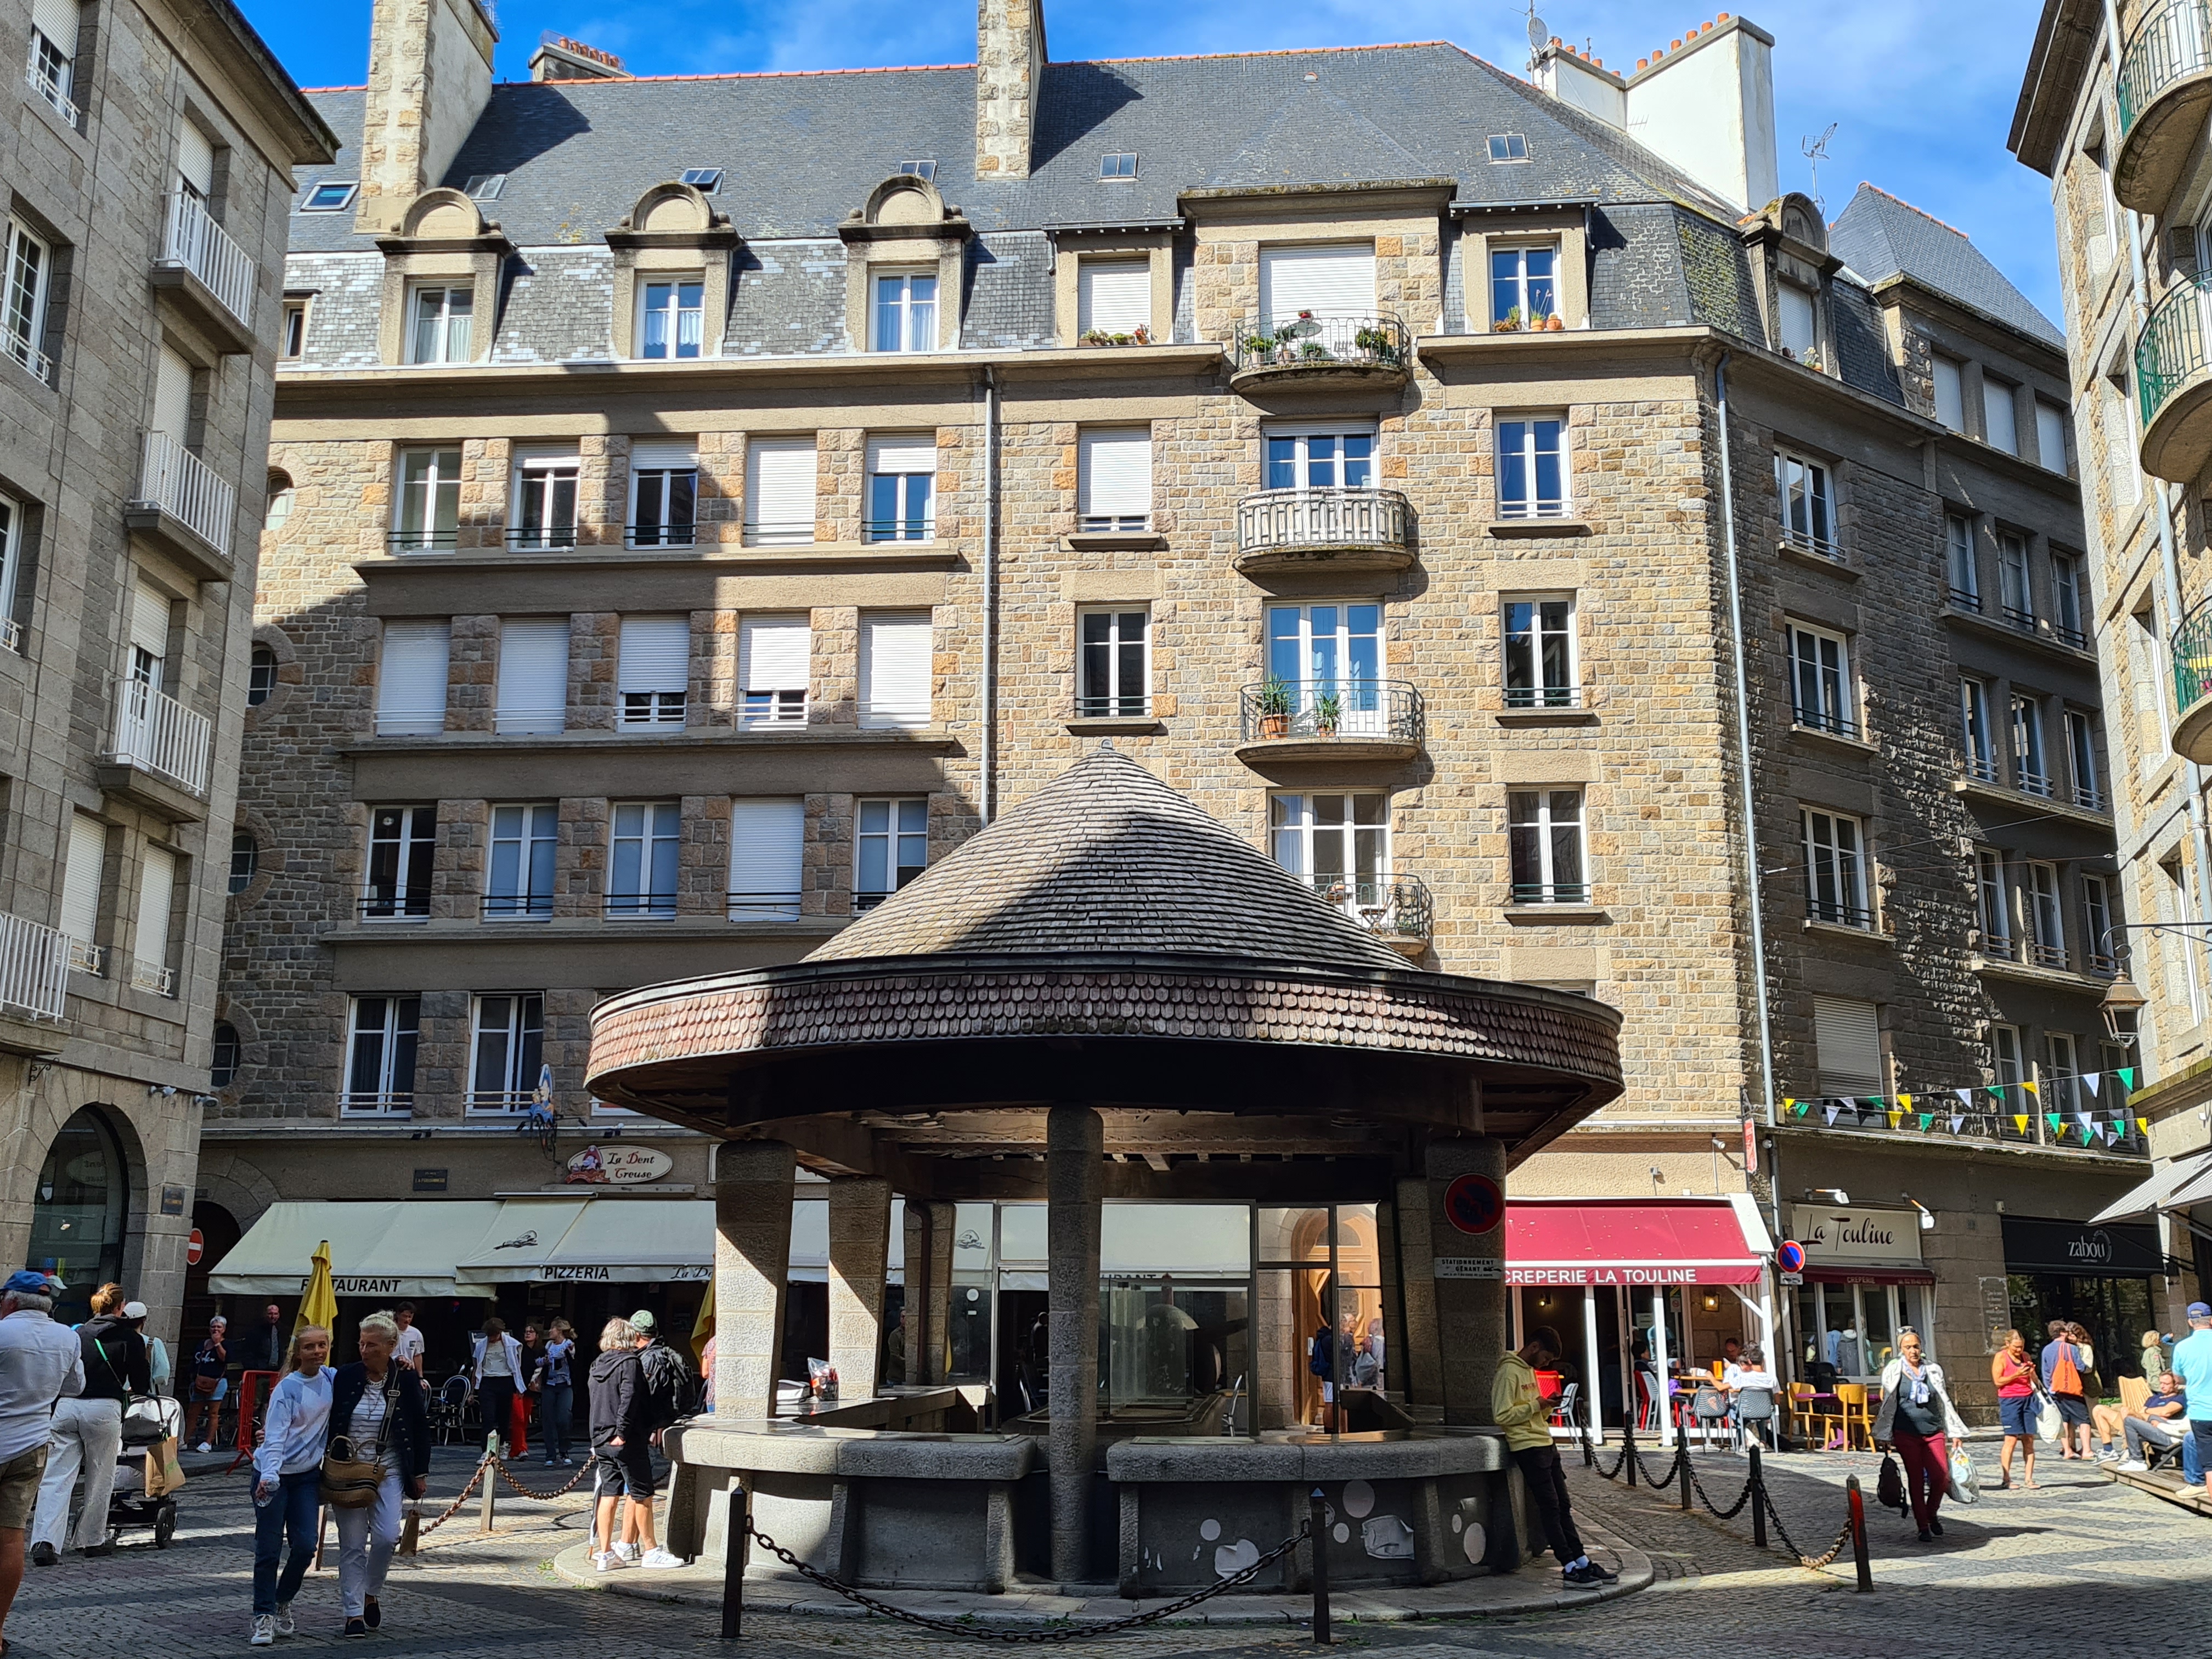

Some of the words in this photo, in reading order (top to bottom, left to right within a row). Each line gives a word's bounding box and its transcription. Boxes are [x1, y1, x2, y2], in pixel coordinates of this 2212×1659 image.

[607, 1152, 622, 1164] La
[627, 1151, 655, 1165] Dent
[1799, 1214, 1827, 1251] La
[1829, 1216, 1895, 1251] Touline
[2067, 1234, 2106, 1258] zabou
[544, 1266, 610, 1280] PIZZERIA
[670, 1267, 689, 1279] La
[1595, 1269, 1617, 1283] LA
[1623, 1269, 1697, 1283] TOULINE
[300, 1278, 402, 1292] RTAURANT
